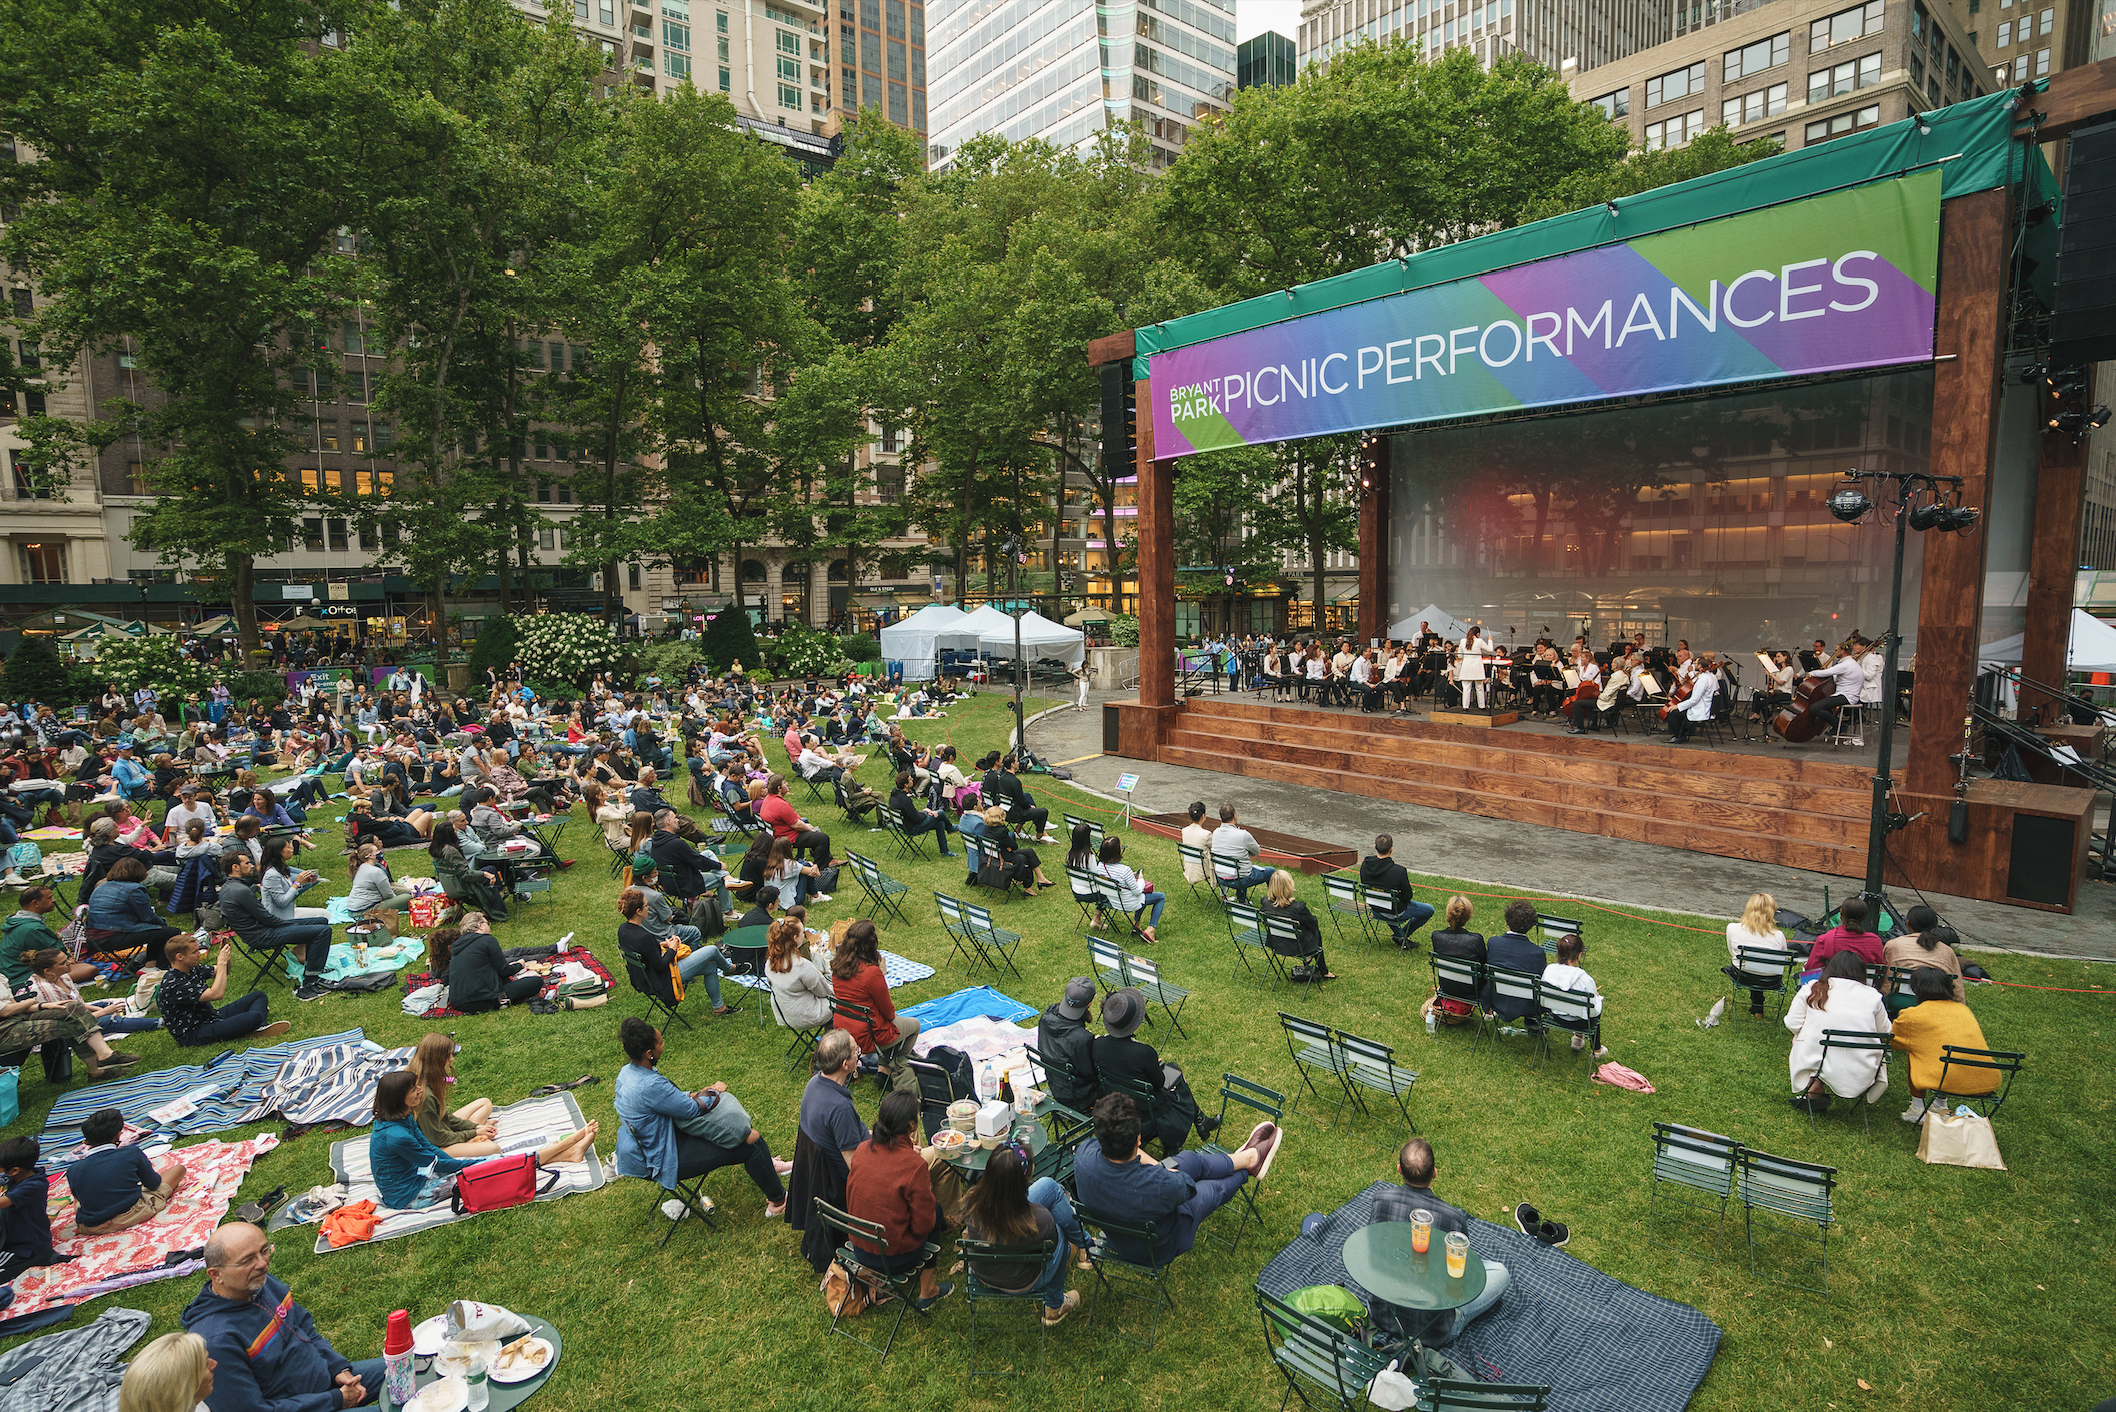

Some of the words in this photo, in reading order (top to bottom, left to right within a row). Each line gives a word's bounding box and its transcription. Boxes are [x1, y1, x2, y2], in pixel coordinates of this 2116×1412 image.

[1224, 353, 1348, 412] PICNIC
[1357, 250, 1879, 390] PERFORMANCES
[1170, 378, 1221, 402] BRYANT
[1170, 395, 1222, 423] PARK
[310, 672, 330, 681] Exit
